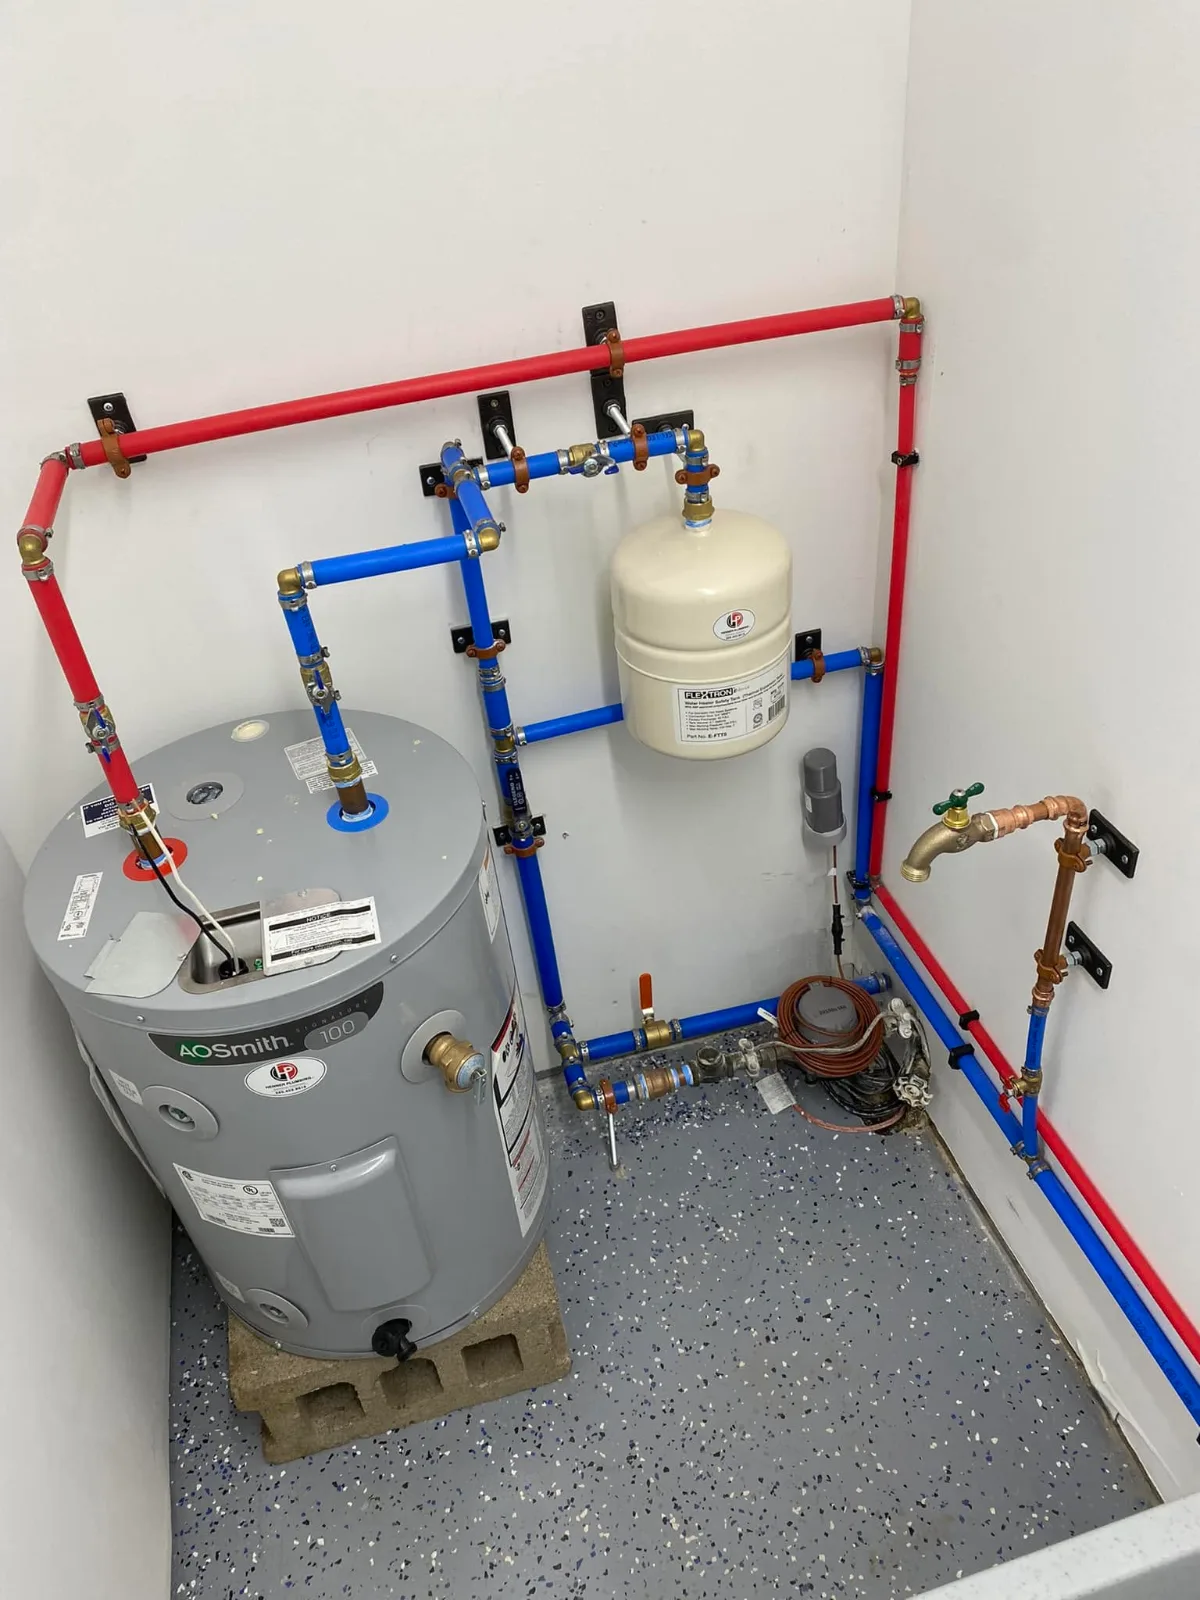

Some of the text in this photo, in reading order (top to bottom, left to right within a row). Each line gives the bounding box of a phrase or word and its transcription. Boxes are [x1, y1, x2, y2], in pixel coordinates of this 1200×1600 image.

[685, 688, 733, 699] FLEXTRON
[306, 913, 331, 923] NOTICE
[296, 999, 368, 1032] SIGNATURE
[319, 1019, 356, 1043] 100
